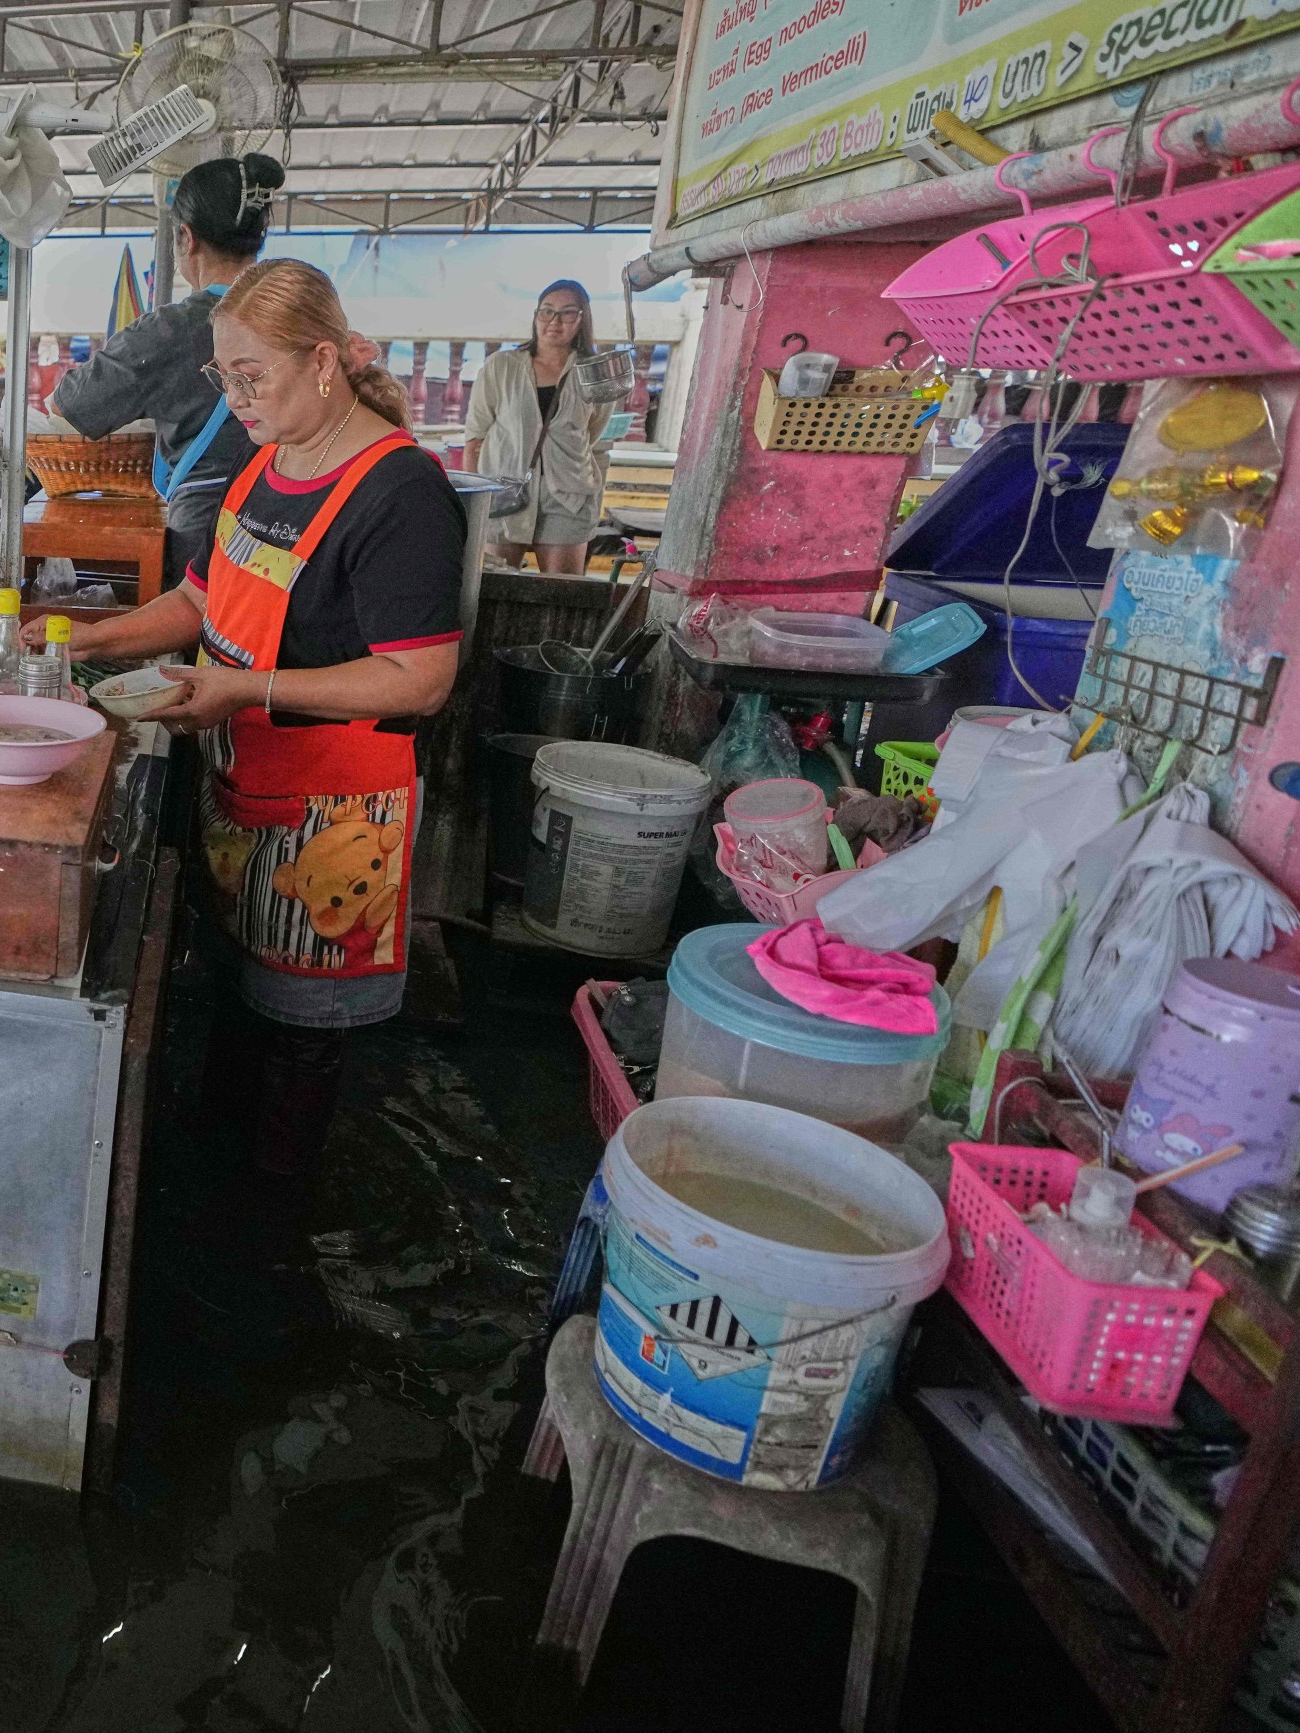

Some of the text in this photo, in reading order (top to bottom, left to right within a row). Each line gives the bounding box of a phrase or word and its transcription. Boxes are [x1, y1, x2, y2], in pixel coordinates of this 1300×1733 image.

[707, 41, 741, 91] บะหมี่
[742, 36, 773, 73] (Egg
[739, 86, 774, 124] (Rice
[781, 31, 867, 97] Vermicelli)
[765, 136, 814, 180] normal
[817, 123, 837, 161] 30
[842, 108, 883, 153] Bath
[964, 75, 989, 113] 40
[1002, 49, 1047, 99] บาท
[637, 831, 665, 839] SUPER
